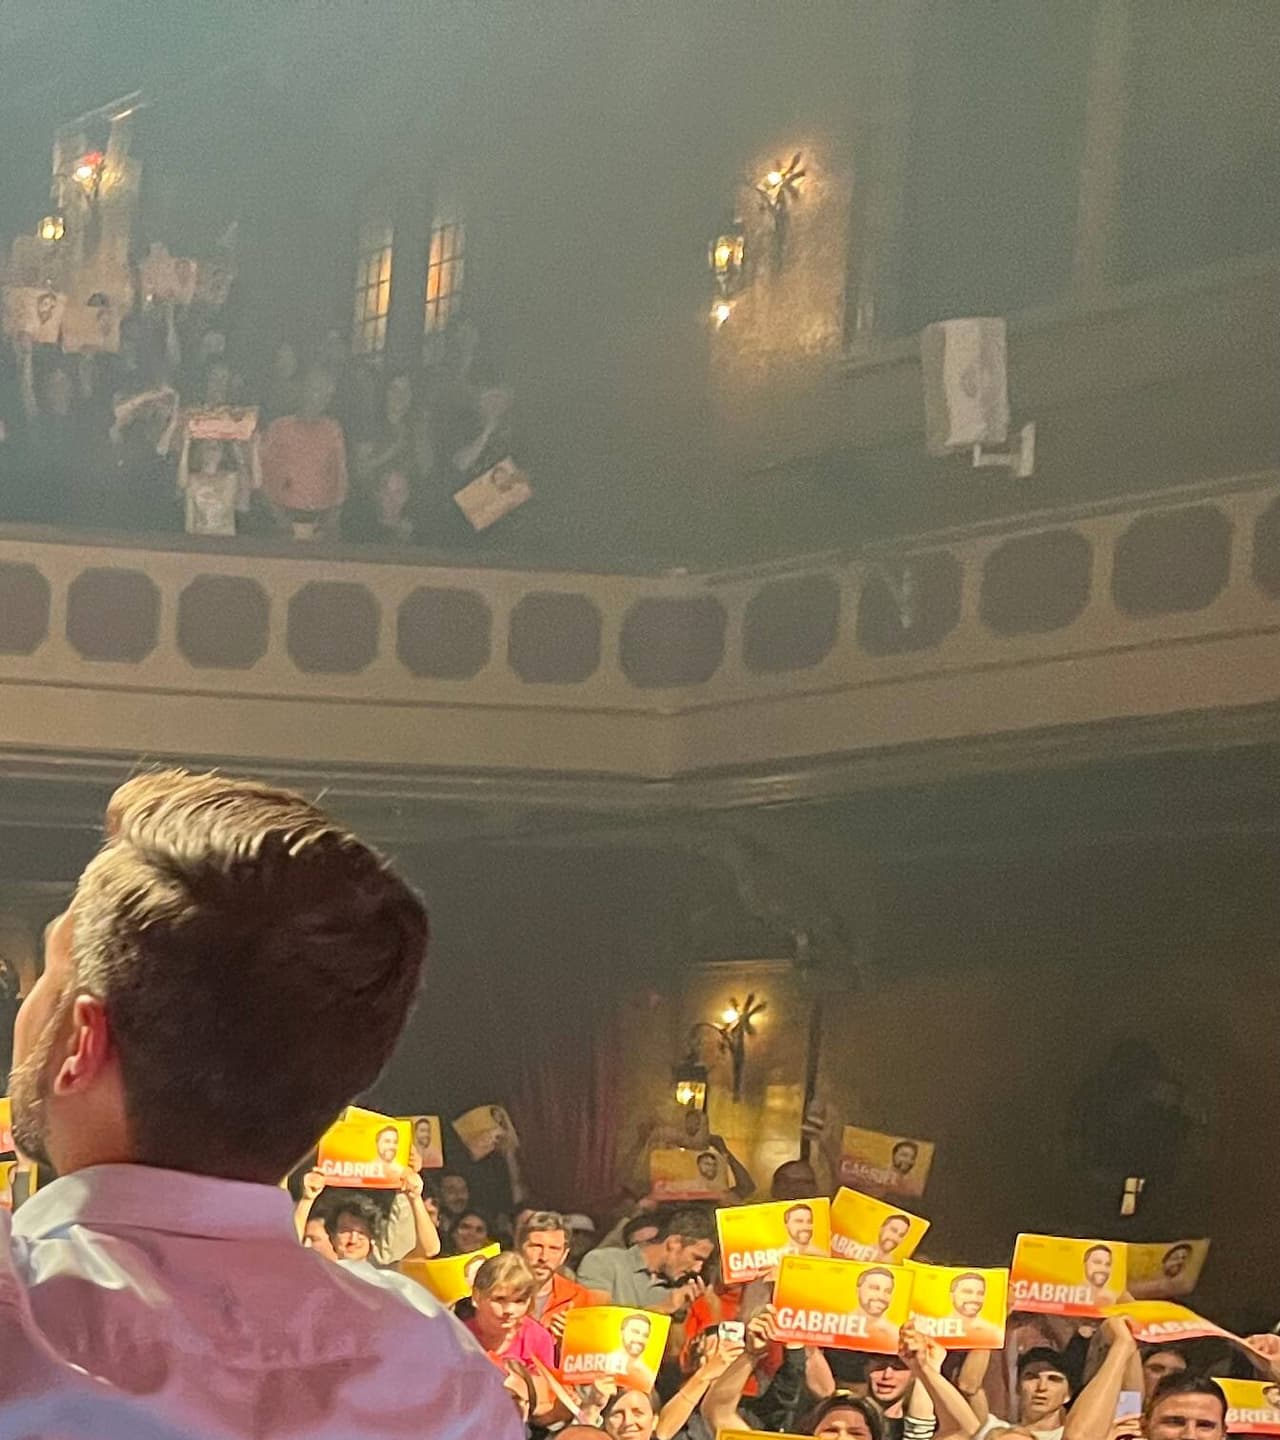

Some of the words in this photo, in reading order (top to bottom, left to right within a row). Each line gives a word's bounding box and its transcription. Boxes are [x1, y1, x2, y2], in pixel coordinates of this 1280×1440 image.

[322, 1160, 385, 1178] GABRIEL
[831, 1233, 880, 1263] ABRIEL
[1013, 1280, 1094, 1305] GABRIEL
[778, 1308, 870, 1338] GABRIEL
